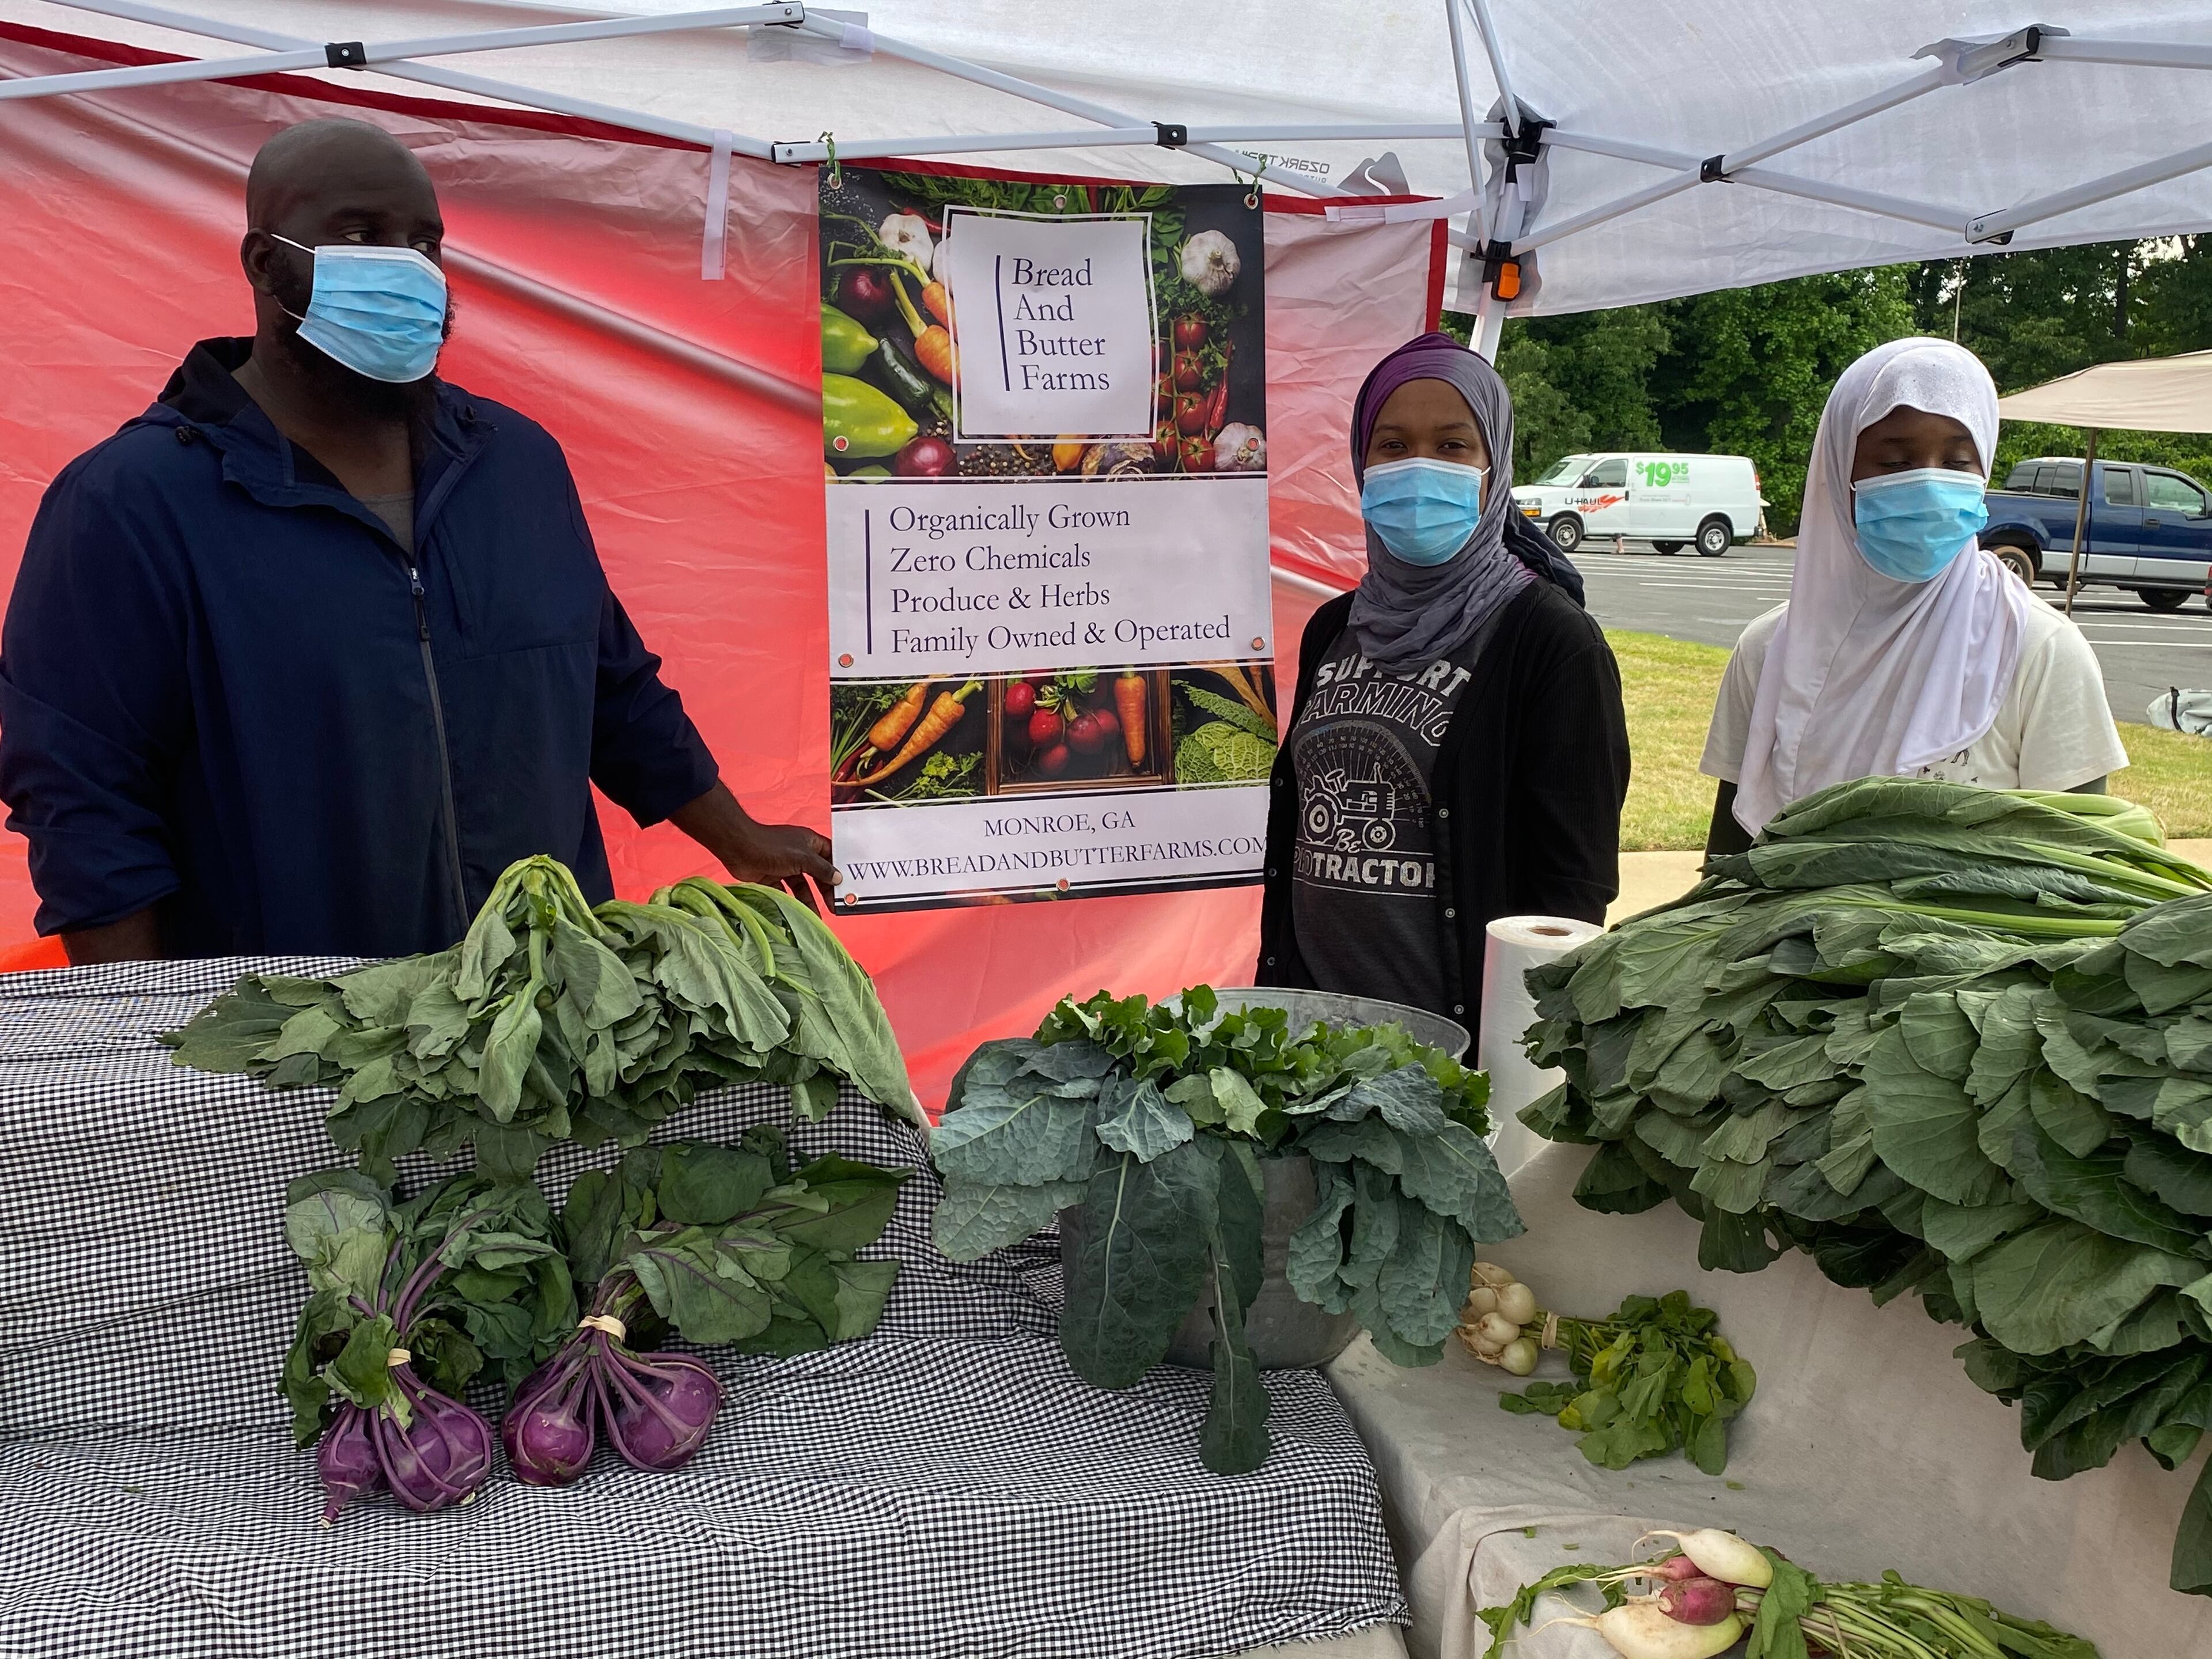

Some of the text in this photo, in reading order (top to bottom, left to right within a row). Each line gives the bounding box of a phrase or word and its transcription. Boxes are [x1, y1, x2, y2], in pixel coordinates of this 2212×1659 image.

[1011, 257, 1093, 286] Bread
[1013, 294, 1075, 321] And
[1016, 329, 1106, 356] Butter
[1020, 364, 1110, 391] Farms
[889, 504, 1130, 540] Organically Grown
[890, 543, 1090, 573] Zero Chemicals
[891, 582, 1110, 613] Produce & Herbs
[892, 615, 1231, 659] Family Owned & Operated
[1317, 653, 1472, 698] SUPRT
[984, 810, 1136, 837] MONROE, GA
[846, 836, 1267, 881] WWW.BREADANDBUTTERFARMS.COM
